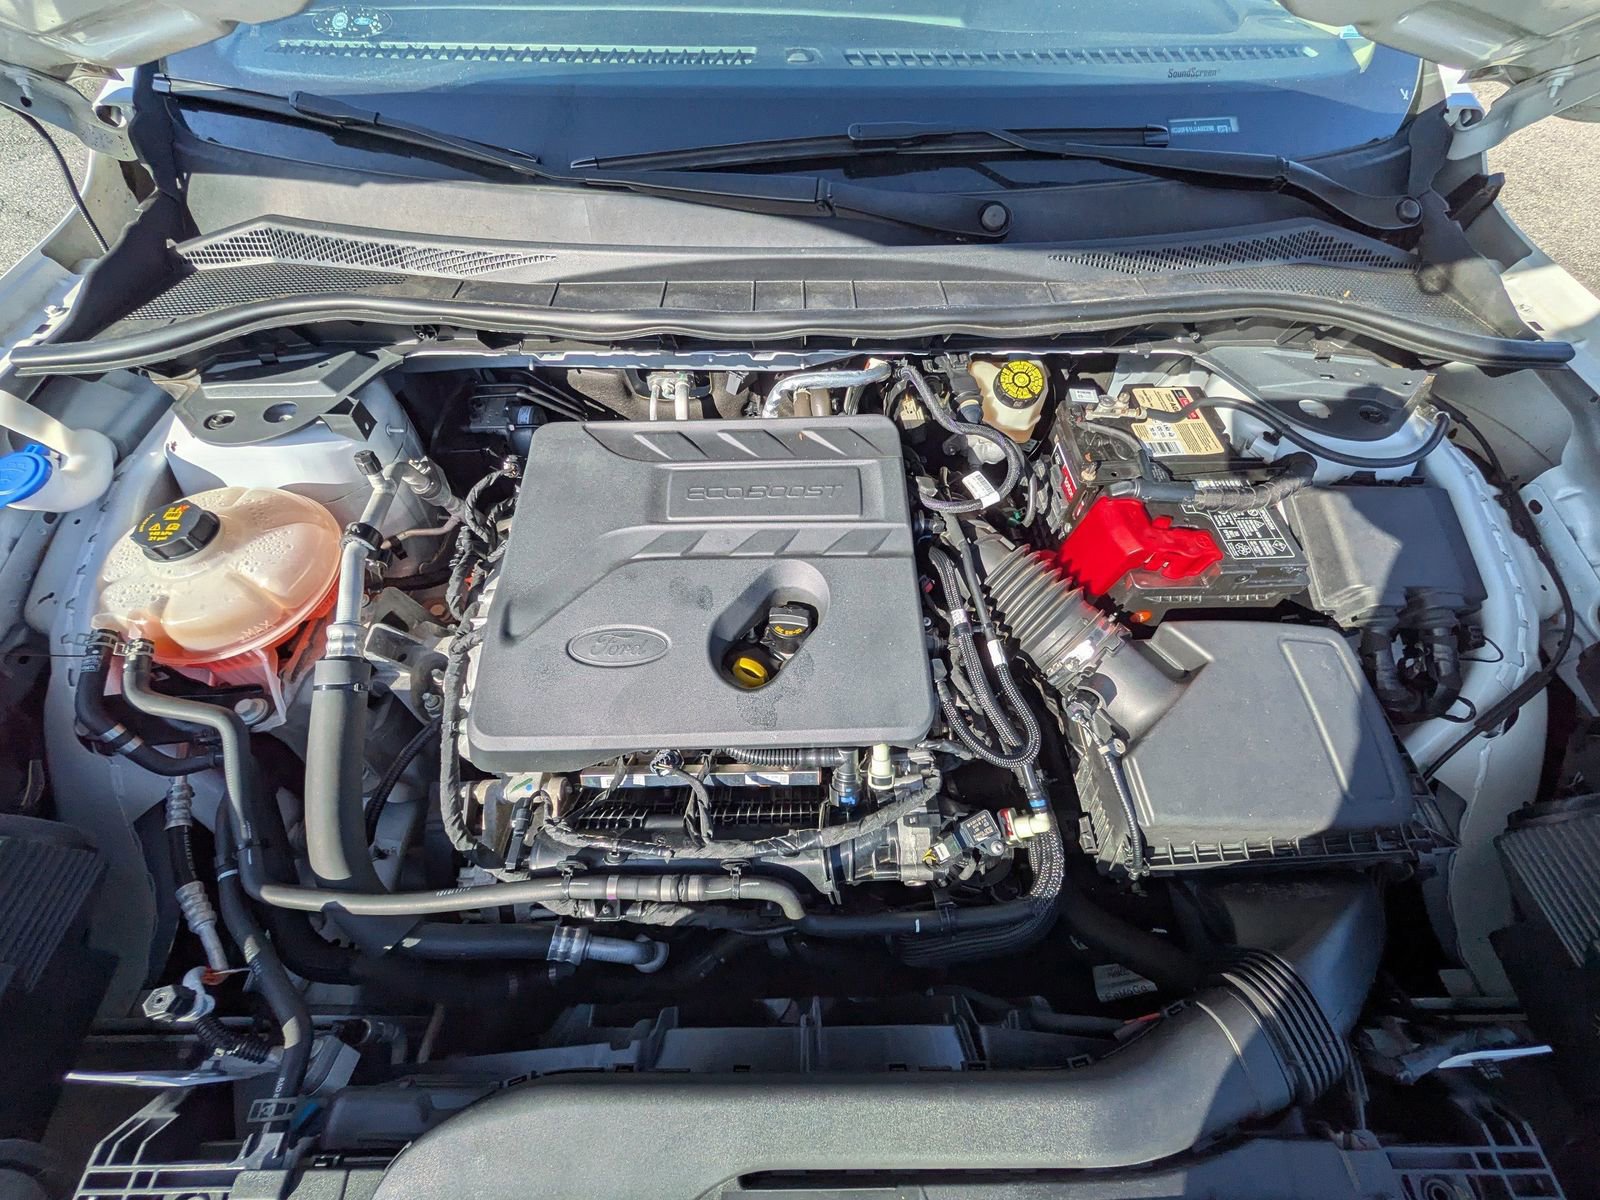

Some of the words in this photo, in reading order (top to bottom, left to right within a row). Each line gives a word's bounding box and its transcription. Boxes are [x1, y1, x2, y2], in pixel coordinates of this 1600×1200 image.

[1167, 67, 1217, 79] SoundScreen
[685, 484, 844, 501] ECOBOOST
[589, 632, 649, 657] Ford
